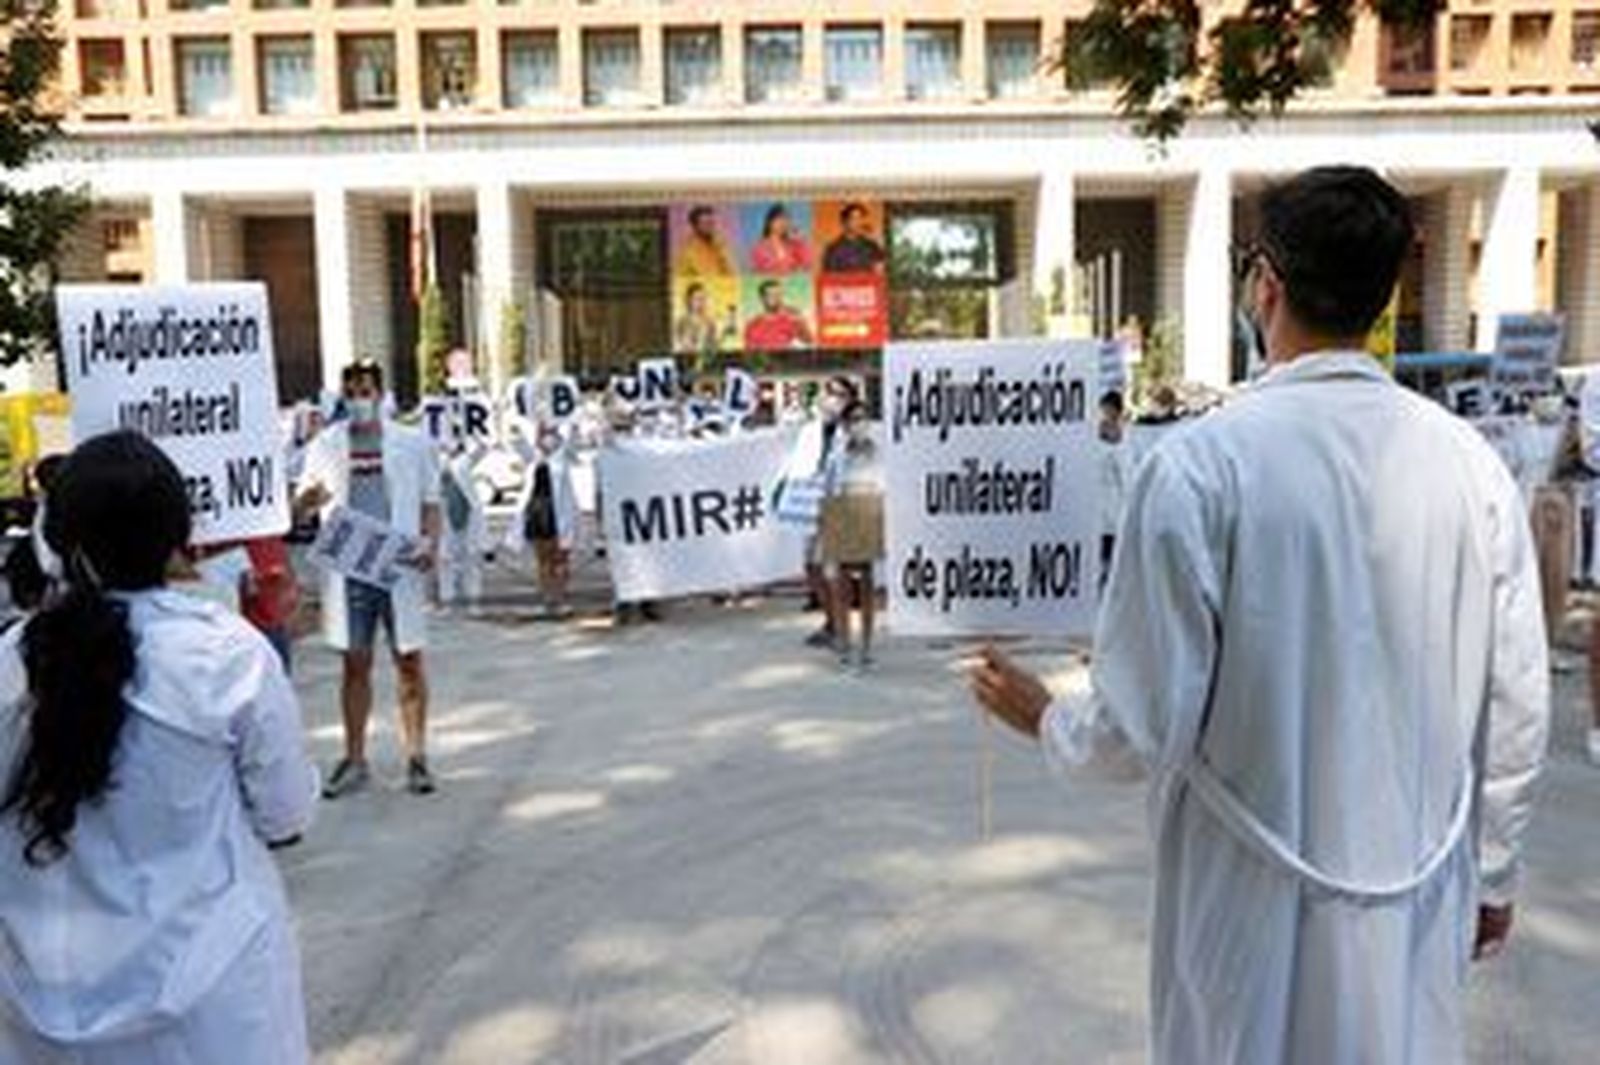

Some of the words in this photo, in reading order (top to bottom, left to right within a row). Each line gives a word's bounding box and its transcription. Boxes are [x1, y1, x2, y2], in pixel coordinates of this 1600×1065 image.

[78, 304, 260, 376] ¡Adjudicación
[118, 381, 241, 436] unilateral
[892, 362, 1085, 442] ¡Adjudicación
[226, 456, 274, 509] NO!
[925, 456, 1054, 514] unilateral
[620, 484, 766, 544] MIR#
[902, 545, 937, 599] de
[942, 545, 1020, 611] plaza,
[1027, 542, 1082, 599] NO!
